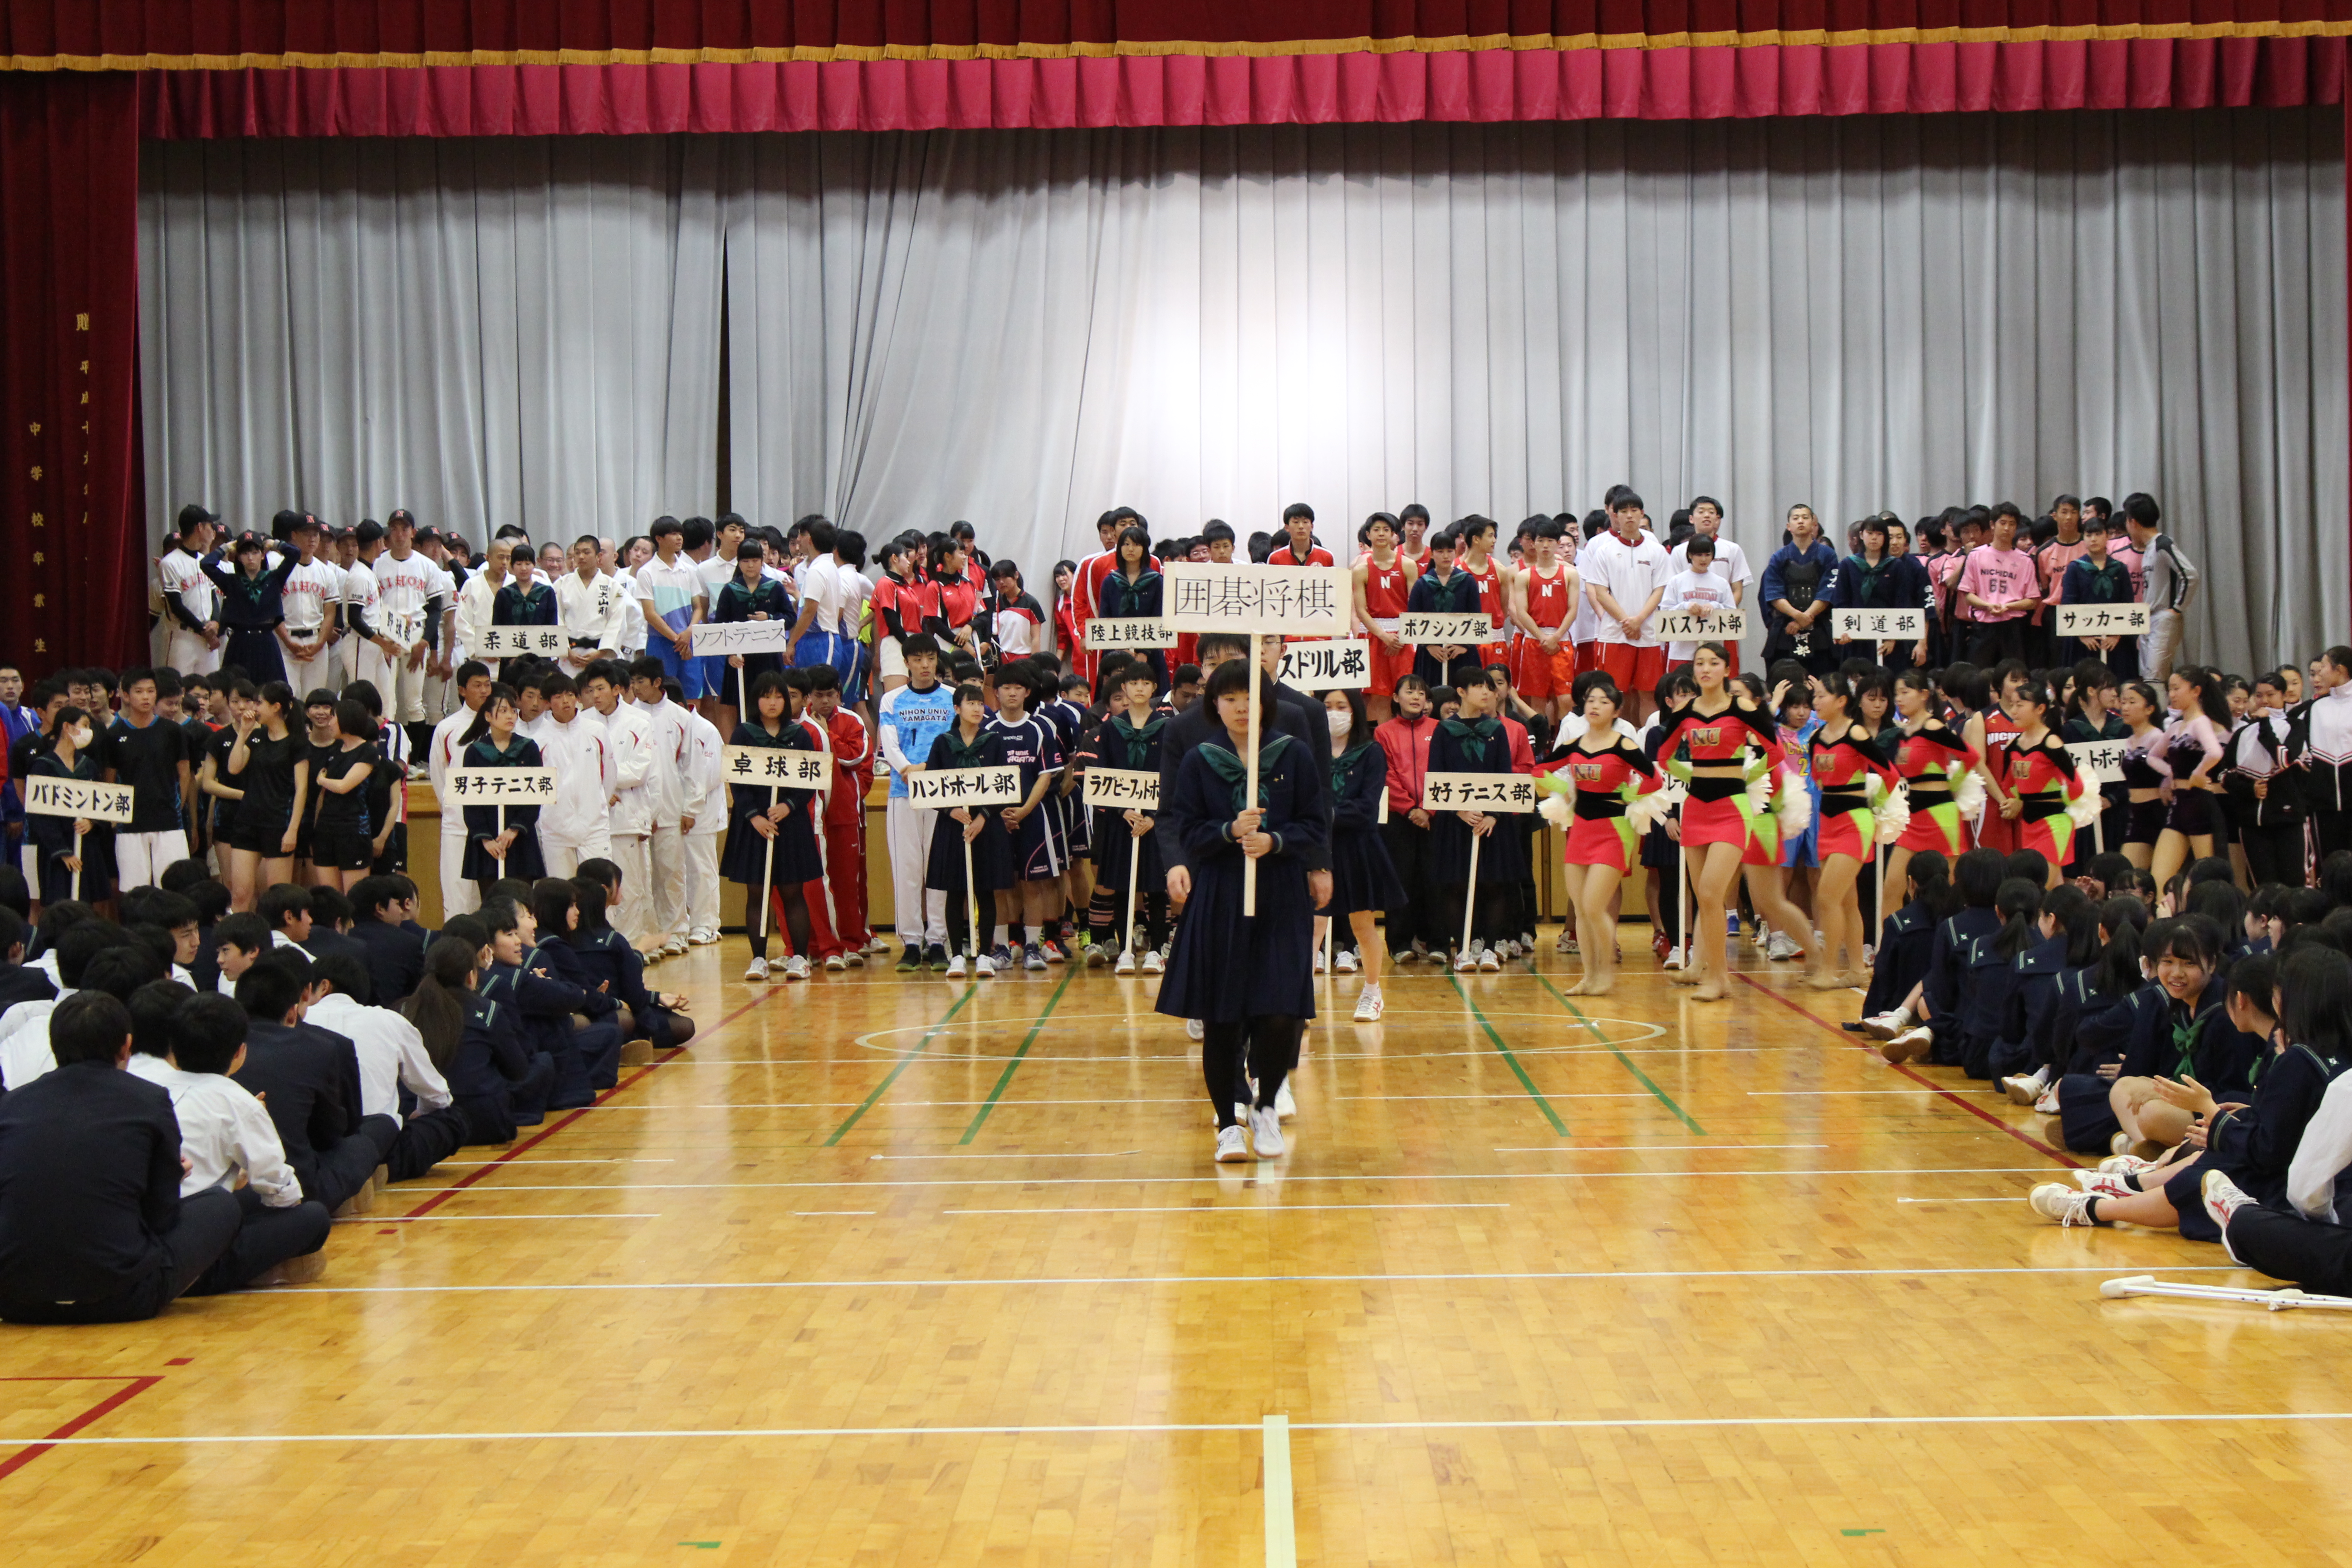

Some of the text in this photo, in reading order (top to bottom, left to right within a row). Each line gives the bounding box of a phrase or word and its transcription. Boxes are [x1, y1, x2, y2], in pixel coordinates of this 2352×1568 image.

[306, 515, 315, 523] N
[1381, 576, 1391, 588] N
[1980, 569, 2017, 579] NICHIDAI
[1478, 580, 1489, 593] N
[1542, 584, 1552, 597] N
[1175, 576, 1335, 618] 囲碁将棋
[1405, 619, 1488, 637] ボクシング部
[1661, 614, 1741, 633] バスケット部
[1842, 614, 1916, 632] 剣道部
[2063, 610, 2144, 629] サッカー部
[484, 631, 558, 650] 柔道部
[694, 627, 786, 648] ソフトテニス
[1091, 624, 1172, 642] 陸上競技部
[1279, 648, 1365, 679] スドリル部
[911, 728, 916, 746] 1
[1691, 727, 1721, 746] NU
[732, 752, 821, 781] 卓球部
[1573, 764, 1602, 782] NU
[455, 776, 554, 795] 男子テニス部
[912, 773, 1015, 799] ハンドボール部
[33, 784, 130, 816] バドミントン部
